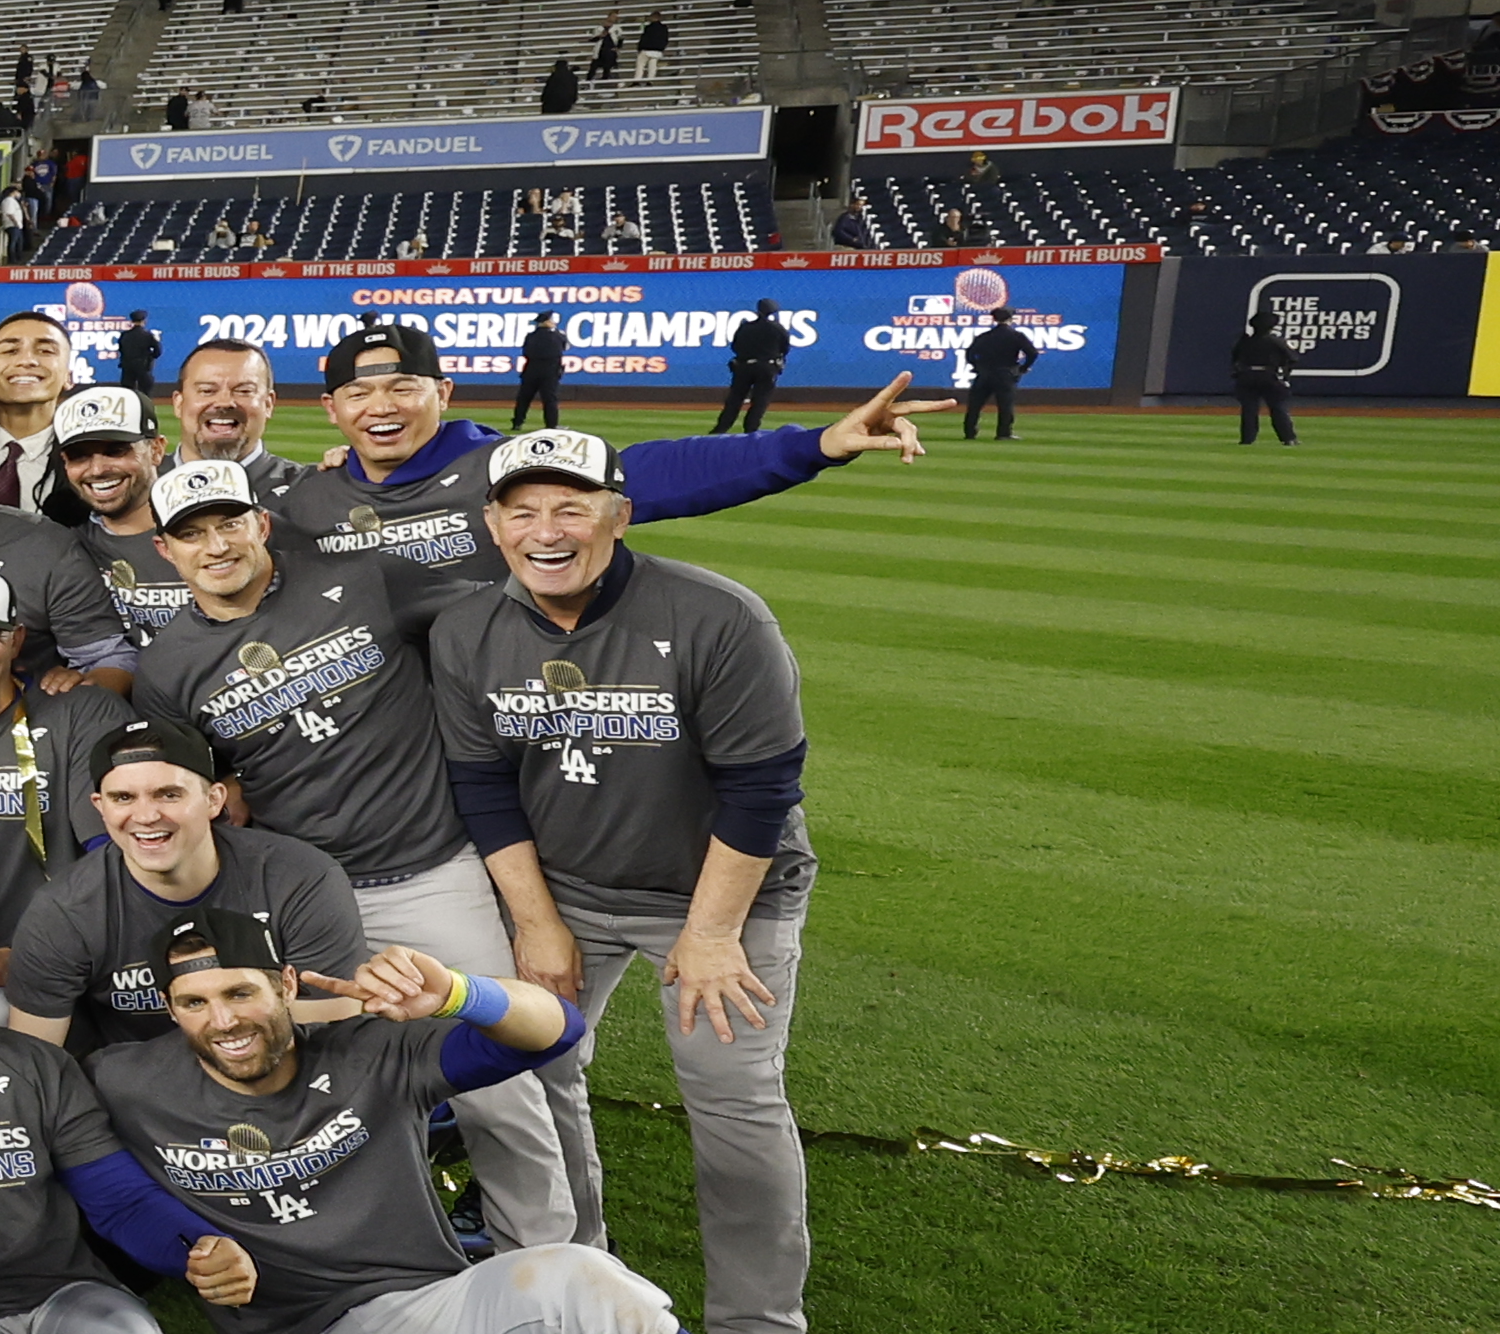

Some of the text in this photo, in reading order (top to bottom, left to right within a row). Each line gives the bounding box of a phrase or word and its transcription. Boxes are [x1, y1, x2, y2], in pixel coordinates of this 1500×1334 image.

[867, 95, 1168, 146] Reebok
[167, 143, 273, 163] FANDUEL
[352, 285, 642, 307] CONGRATULATIONS
[1271, 297, 1318, 311] THE
[488, 692, 674, 715] WORLD SERIES
[494, 711, 679, 740] CHAMPIONS
[560, 738, 597, 784] LA
